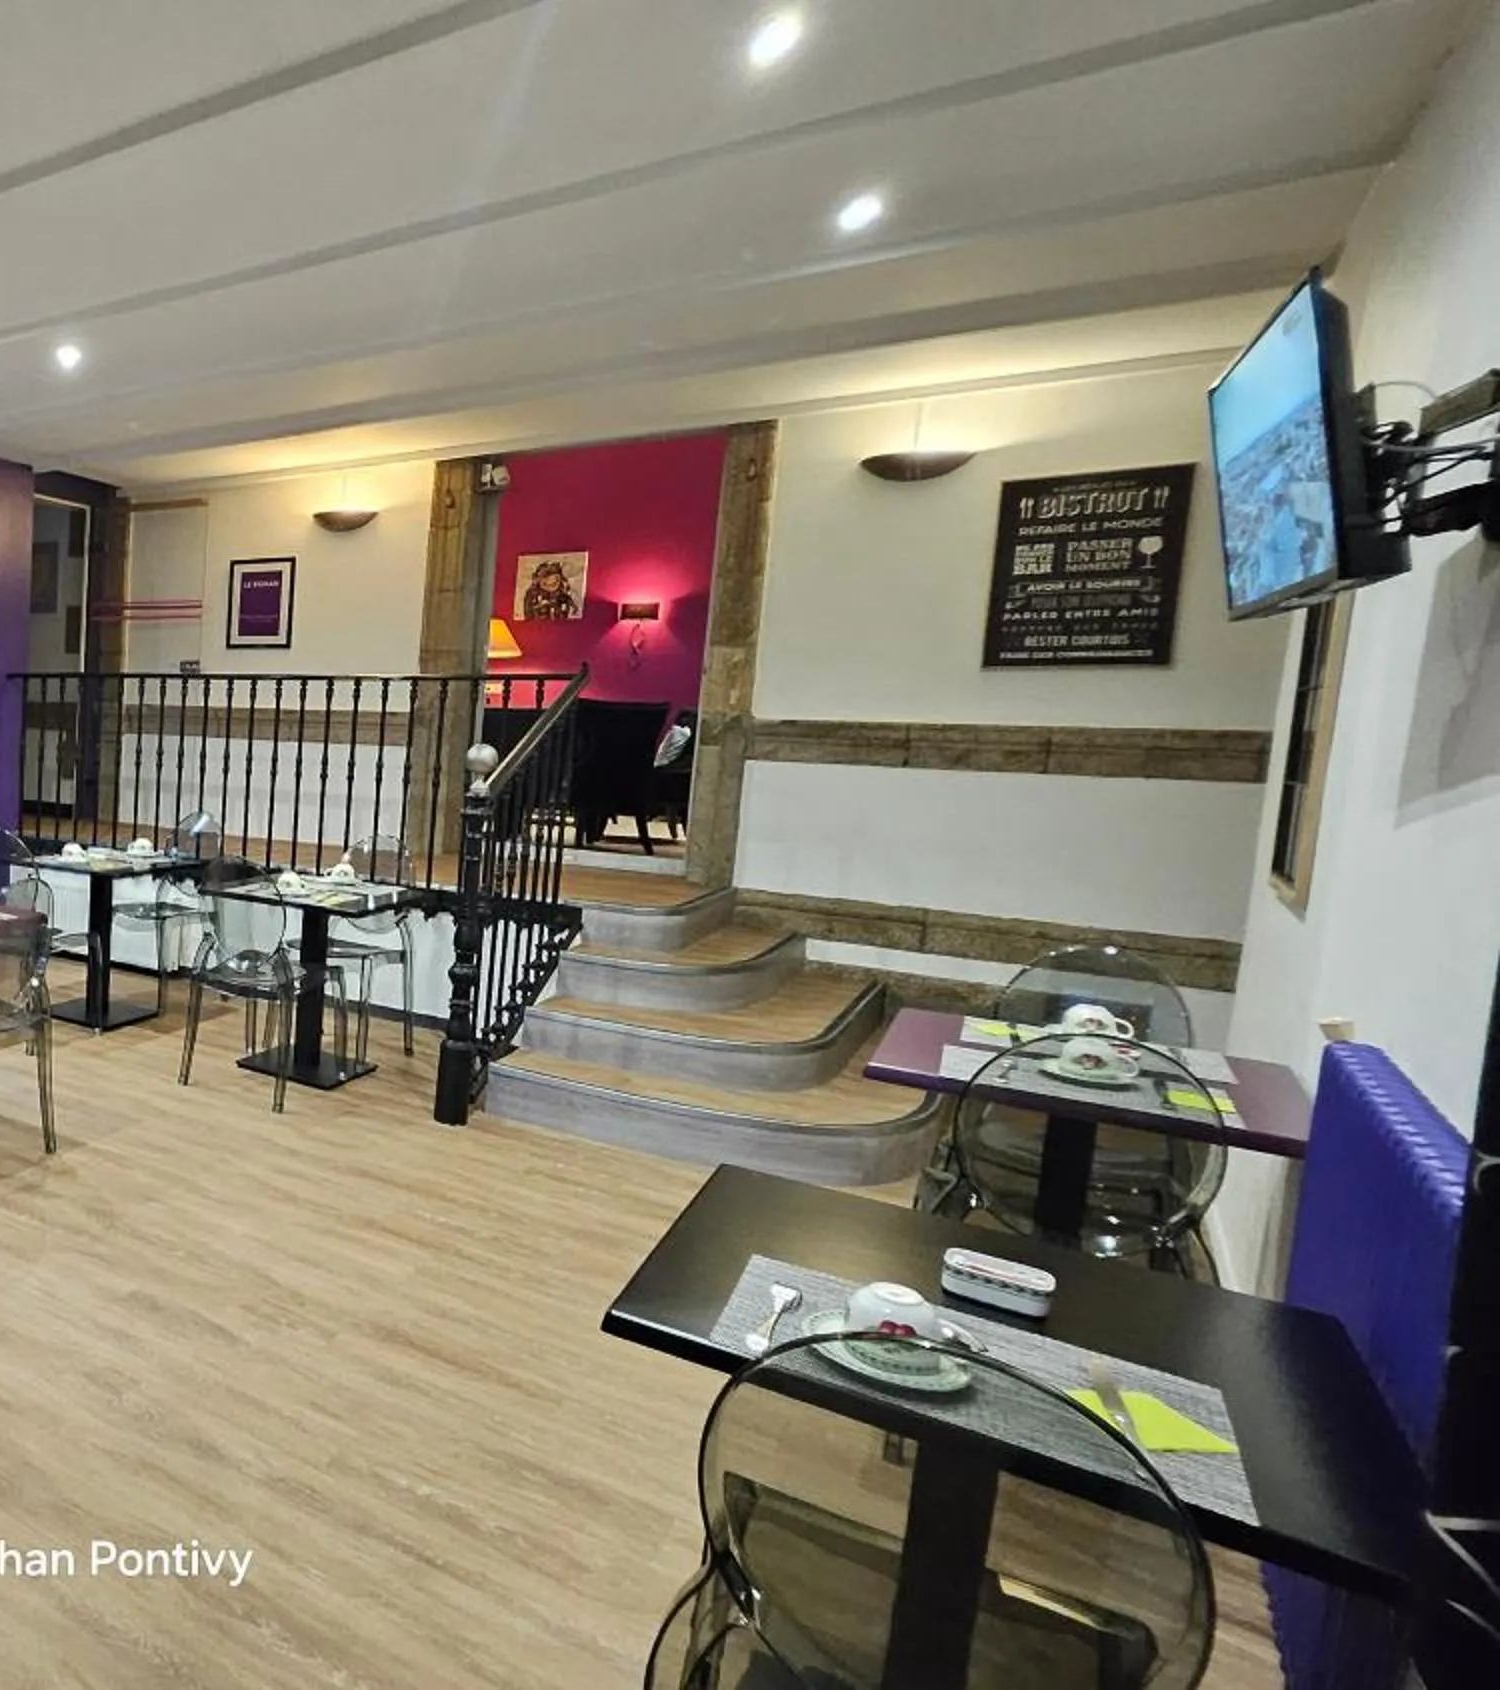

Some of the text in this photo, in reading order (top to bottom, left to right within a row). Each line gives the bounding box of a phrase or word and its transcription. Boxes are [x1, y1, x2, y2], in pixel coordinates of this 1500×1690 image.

[1018, 516, 1164, 537] REFAIRE LE MONDE
[1067, 538, 1134, 551] PASSER
[1066, 551, 1091, 563] UN
[1095, 549, 1132, 561] BON
[1065, 562, 1131, 573] MOMENT
[1069, 580, 1082, 590] LE
[1002, 607, 1160, 621] PARLER ENTRE AMIS
